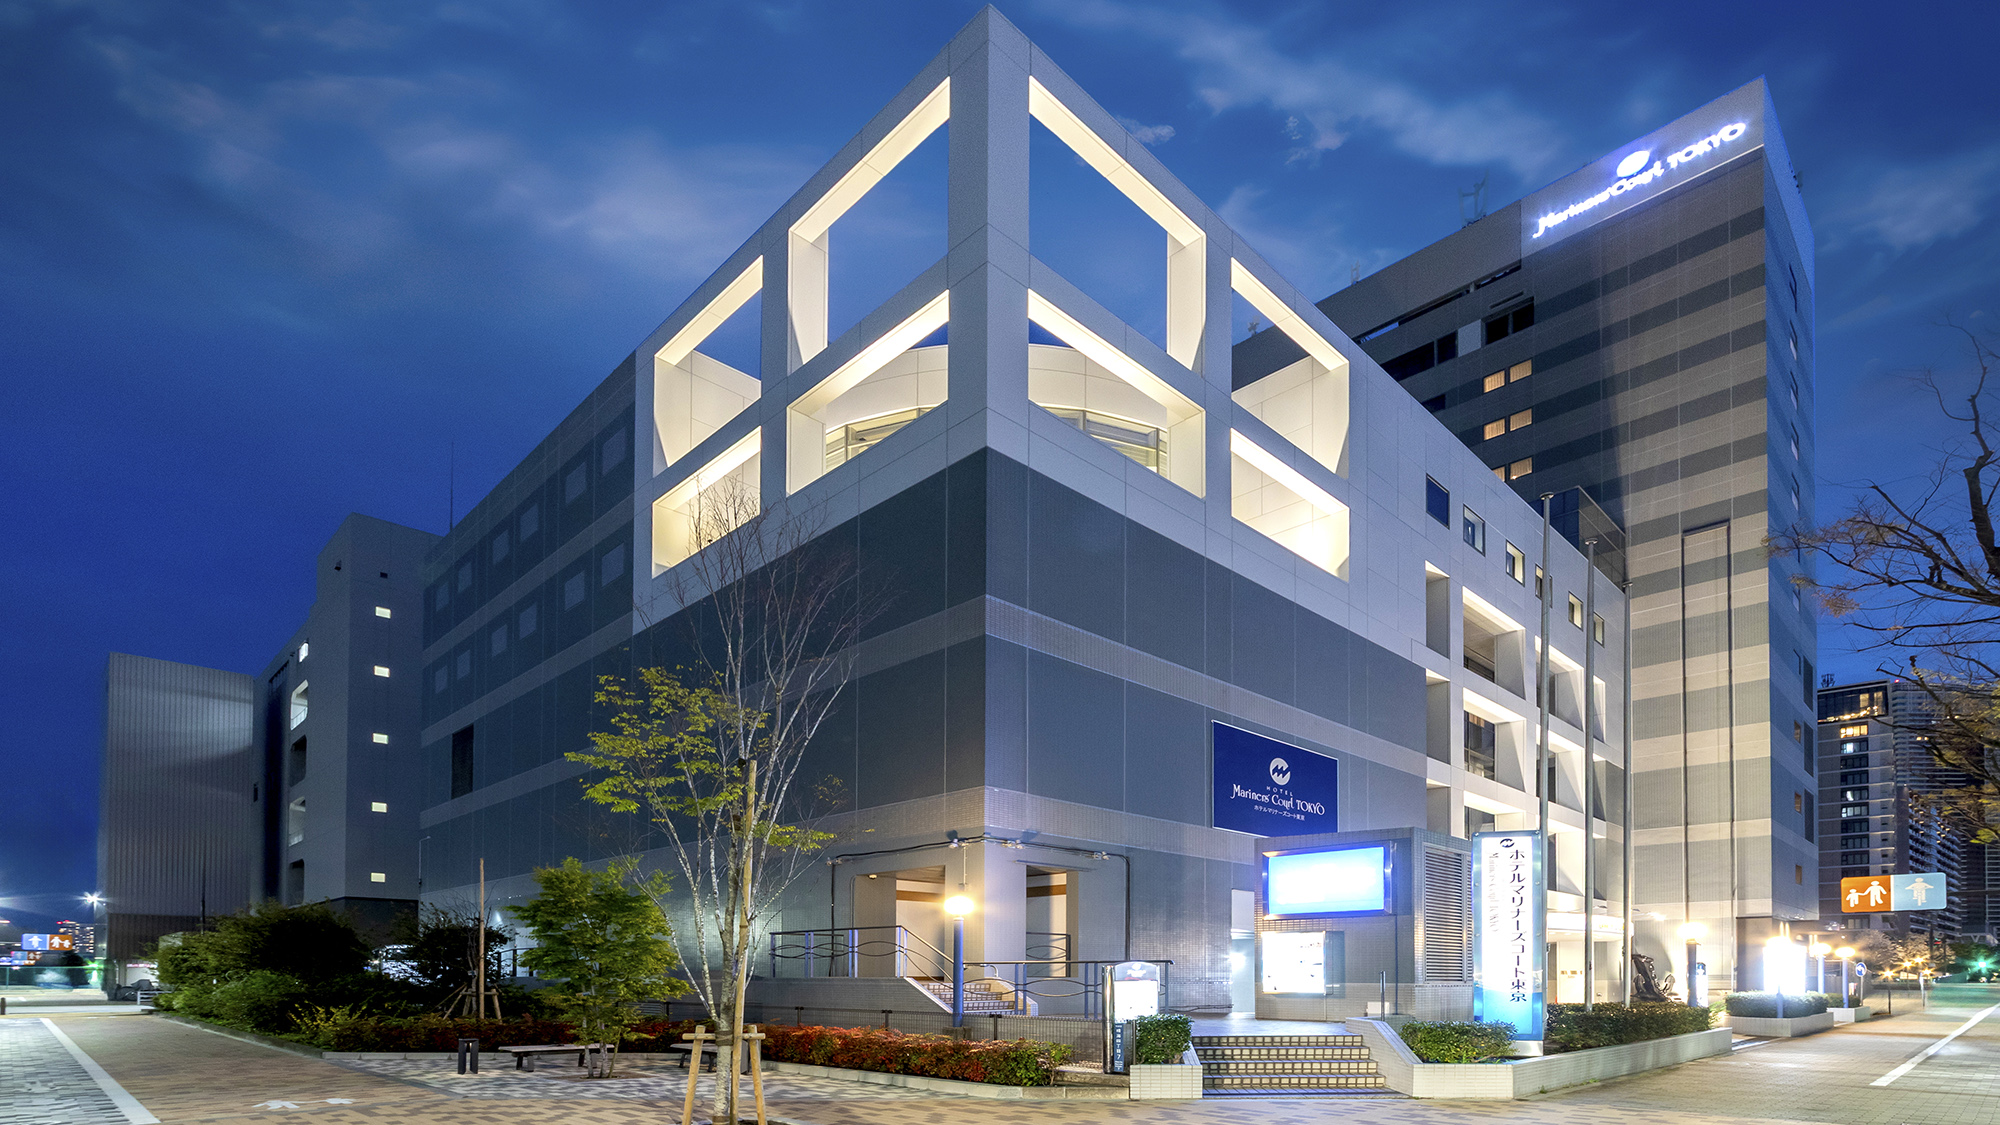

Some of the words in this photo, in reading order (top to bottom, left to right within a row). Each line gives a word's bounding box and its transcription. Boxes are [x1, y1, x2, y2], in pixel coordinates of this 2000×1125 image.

[1667, 122, 1746, 167] TOKYO
[1266, 785, 1293, 797] HOTEL
[1271, 794, 1295, 810] Court
[1295, 799, 1325, 816] TOKYO
[1510, 849, 1527, 1003] ホテルマリナーズコート東京
